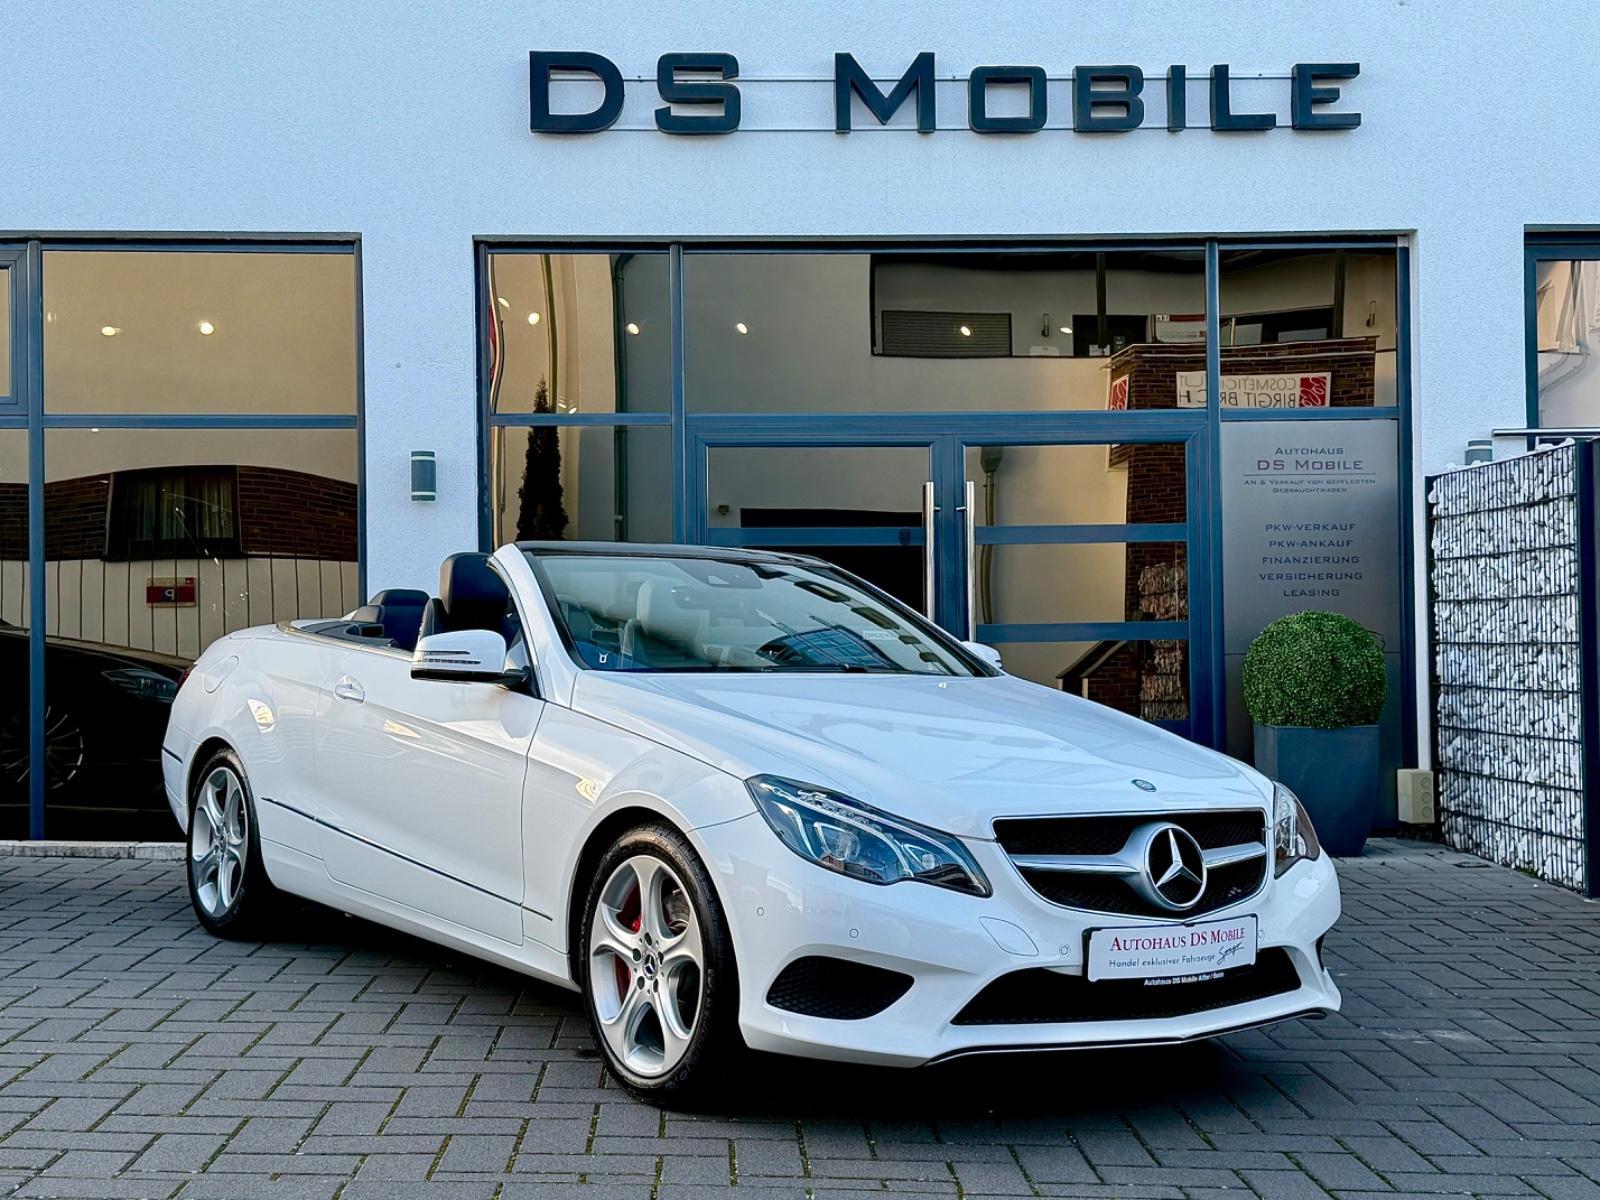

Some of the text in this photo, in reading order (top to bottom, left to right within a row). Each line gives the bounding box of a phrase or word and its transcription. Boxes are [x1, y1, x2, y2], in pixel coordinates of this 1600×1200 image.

[529, 50, 1361, 135] DS MOBILE
[1275, 447, 1344, 456] AUTOHAUS
[1257, 459, 1364, 471] DS MOBILE
[1265, 523, 1356, 532] PKW-VERKAUF
[1269, 540, 1353, 548] PKW-ANKAUF
[1262, 556, 1360, 564] FINANZIERUNG
[1259, 572, 1362, 581] VERSICHERUNG
[1283, 589, 1340, 597] LEASING
[1109, 927, 1246, 951] AUTOHAUS DS MOBILE
[1108, 954, 1216, 968] Handel exklusiver Fahrzeuge
[1144, 978, 1172, 986] Autohaus
